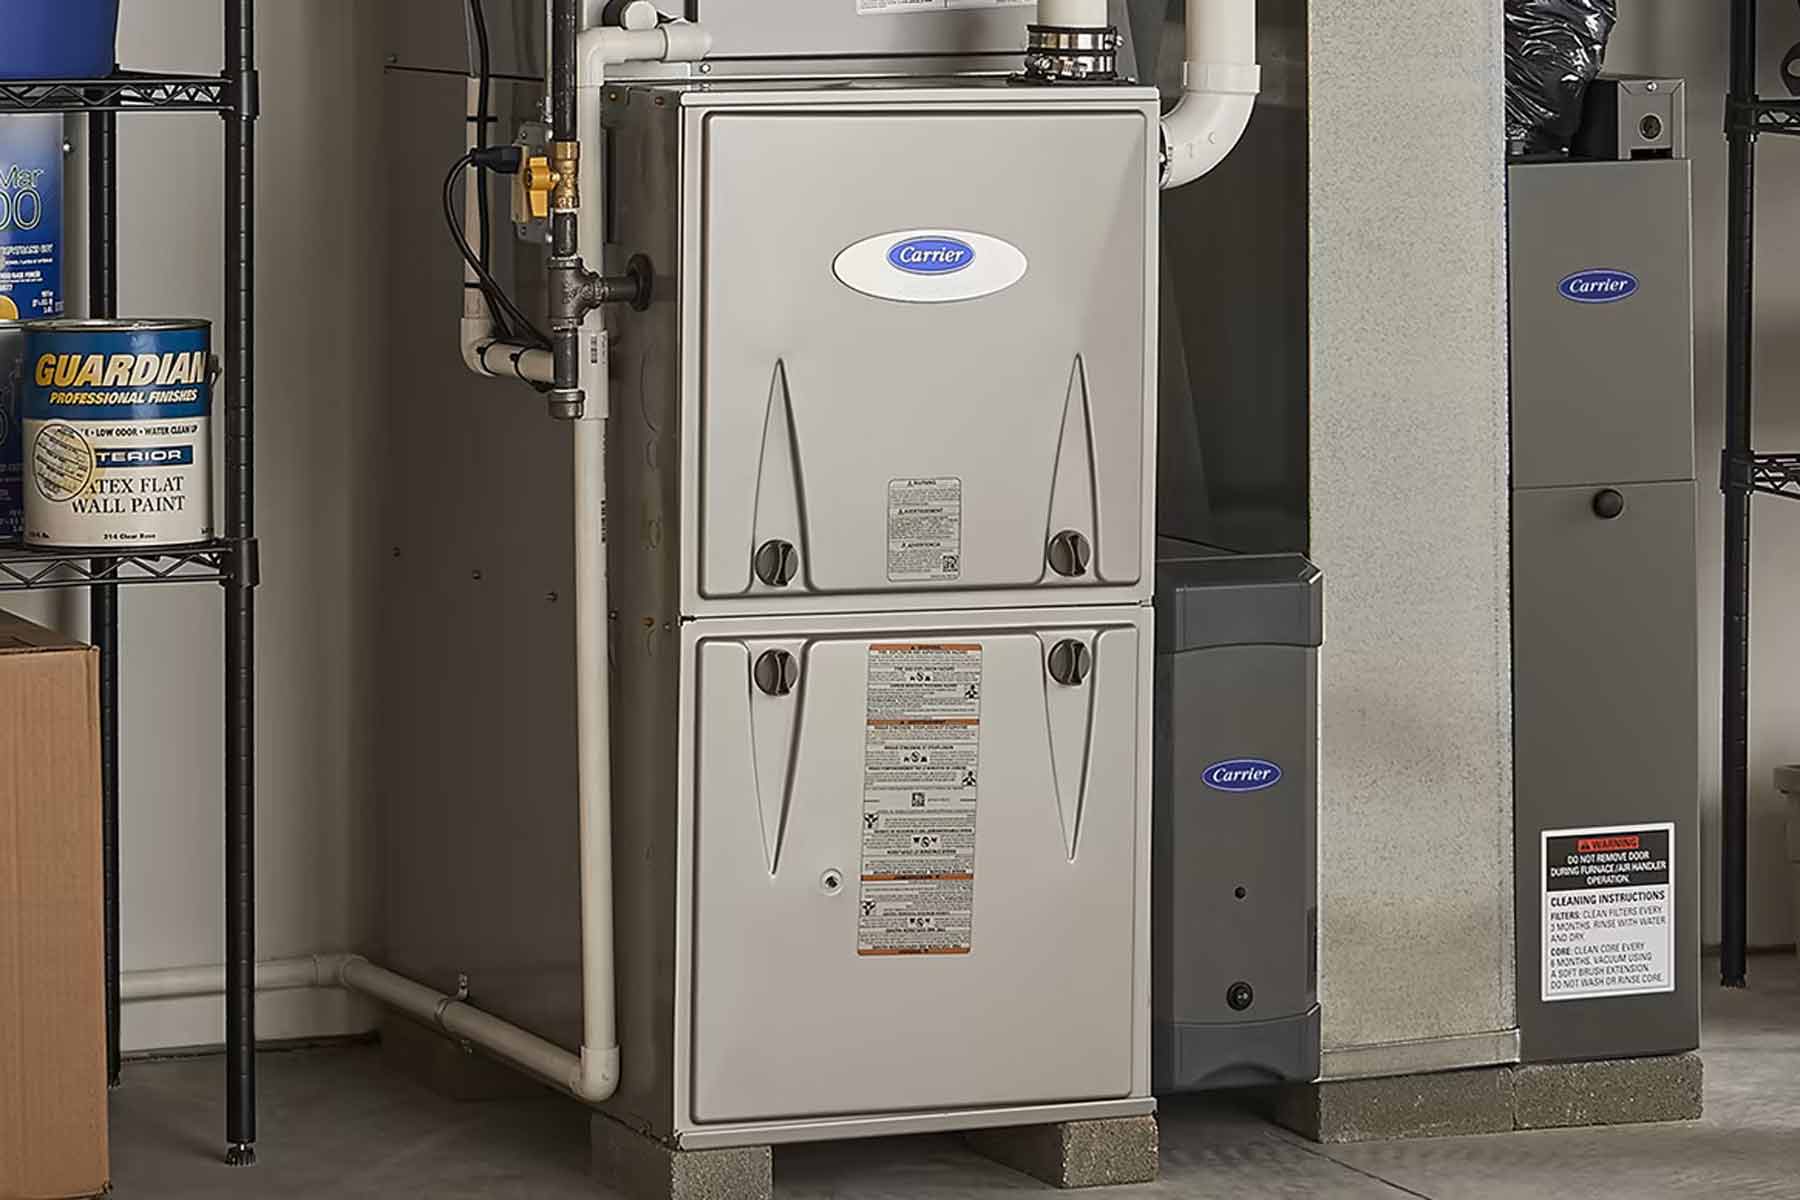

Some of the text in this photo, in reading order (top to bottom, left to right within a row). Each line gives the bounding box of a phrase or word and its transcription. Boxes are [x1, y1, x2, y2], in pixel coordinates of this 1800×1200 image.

[900, 246, 964, 264] Carrier
[1569, 278, 1628, 294] Carrier
[34, 351, 207, 387] GUARDIAN
[50, 388, 198, 405] PROFESSIONAL FINISHES
[95, 427, 113, 438] LOW
[115, 427, 138, 438] ODOR
[144, 425, 169, 436] WATER
[96, 450, 181, 462] TERIOR
[86, 476, 184, 495] ATEX FLAT
[72, 496, 185, 514] WALL PAINT
[1213, 768, 1271, 783] Carrier
[1591, 838, 1637, 849] WARNING
[1567, 851, 1650, 865] DO NOT REMOVE DOOR
[1551, 866, 1579, 877] DURING
[1631, 860, 1666, 871] HANDLER
[1551, 890, 1665, 907] CLEANING INSTRUCTIONS
[1583, 909, 1608, 919] CLEAN
[1609, 907, 1637, 917] FILTERS
[1639, 905, 1662, 915] EVERY
[1593, 919, 1616, 928] RINSE
[1617, 918, 1638, 927] WITH
[1639, 916, 1665, 925] WATER
[1551, 934, 1567, 942] AND
[1574, 945, 1599, 955] CLEAN
[1600, 943, 1620, 953] CORE
[1622, 942, 1645, 952] EVERY
[1592, 954, 1626, 964] VACUUM
[1628, 952, 1652, 961] USING
[1558, 968, 1577, 978] SOFT
[1579, 966, 1604, 976] BRUSH
[1551, 980, 1561, 990] DO
[1562, 979, 1578, 989] NOT
[1580, 977, 1604, 987] WASH
[1606, 976, 1616, 986] OR
[1618, 974, 1640, 984] RINSE
